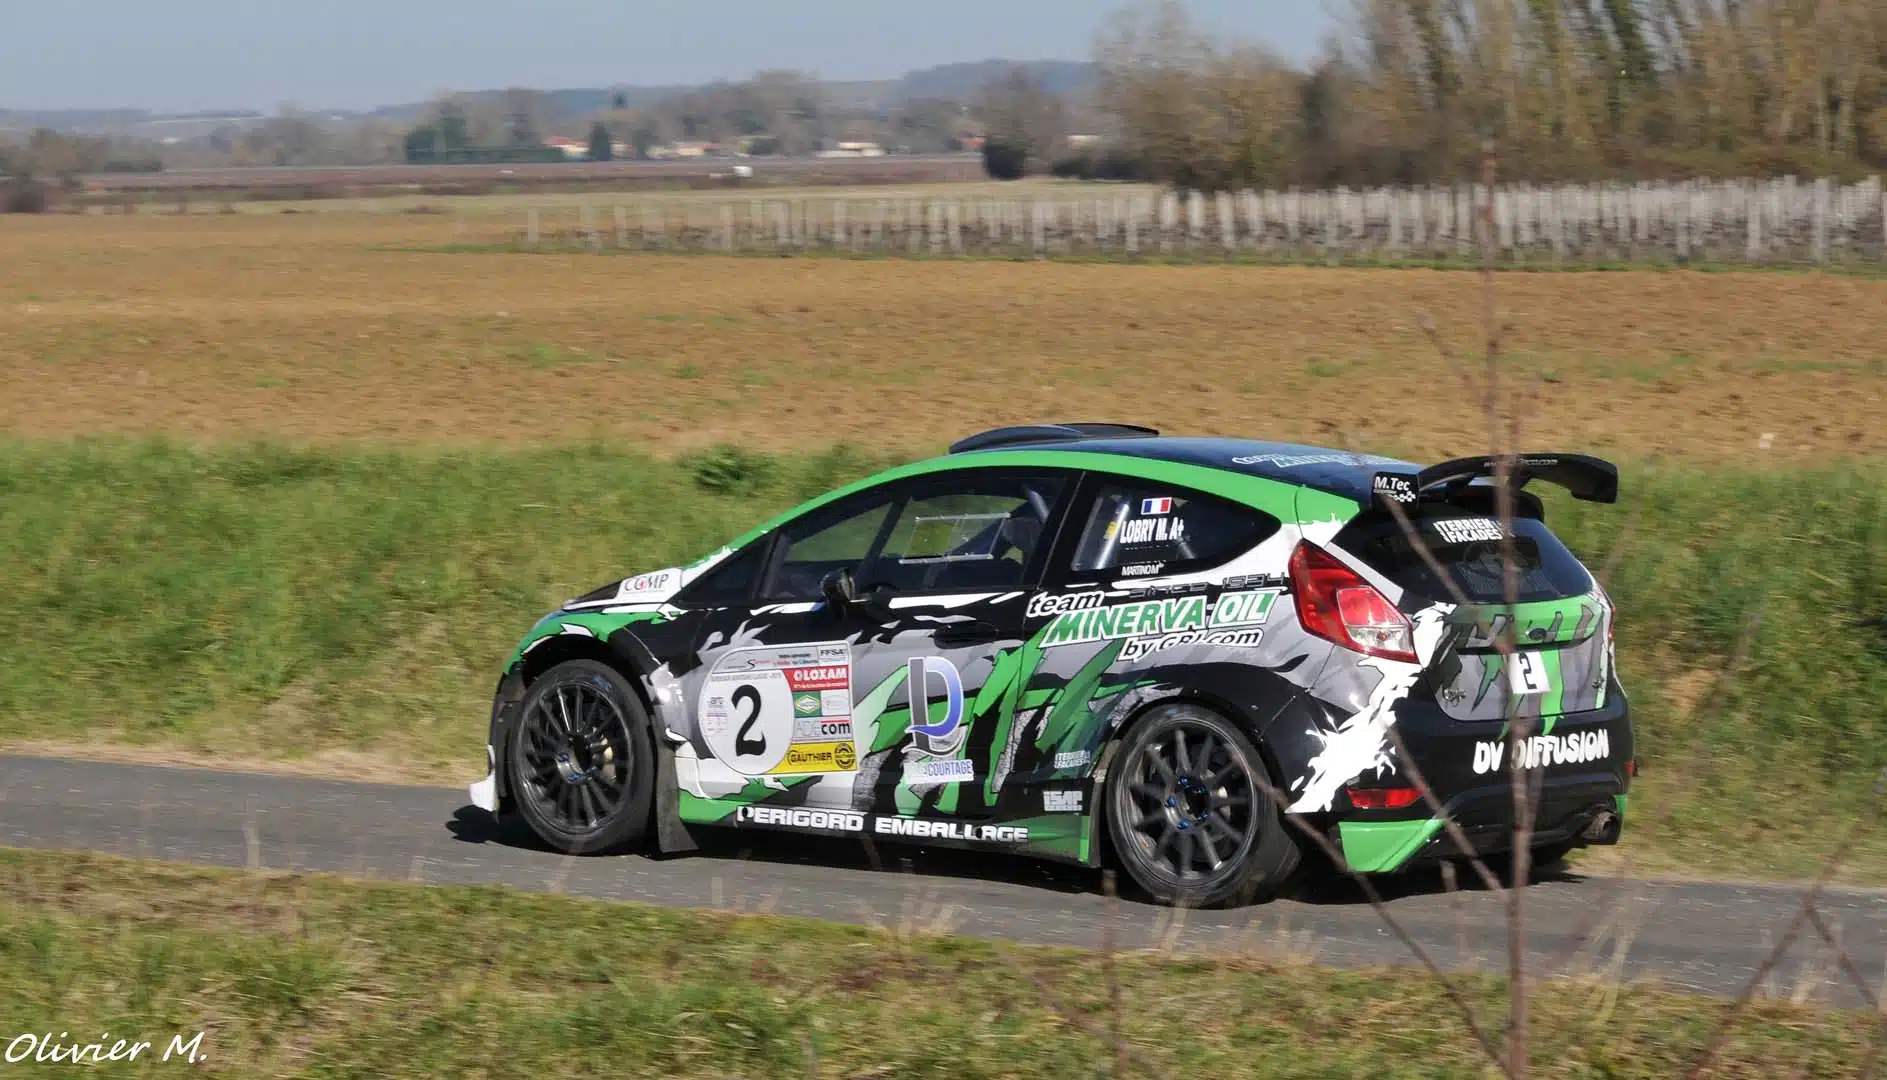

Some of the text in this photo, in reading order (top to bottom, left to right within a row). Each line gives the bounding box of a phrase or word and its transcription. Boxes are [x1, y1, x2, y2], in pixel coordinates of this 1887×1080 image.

[1374, 476, 1411, 491] M.Tec
[1120, 519, 1157, 544] LOBRY
[1029, 592, 1103, 614] team
[1045, 592, 1276, 644] MINERVA OIL
[1124, 637, 1154, 660] by
[1518, 652, 1538, 690] 2
[731, 684, 767, 757] 2
[790, 752, 832, 763] GAUTHIER
[1473, 729, 1610, 774] DV DIFFUSION
[737, 805, 1028, 843] PERIGORD EMBALLAGE
